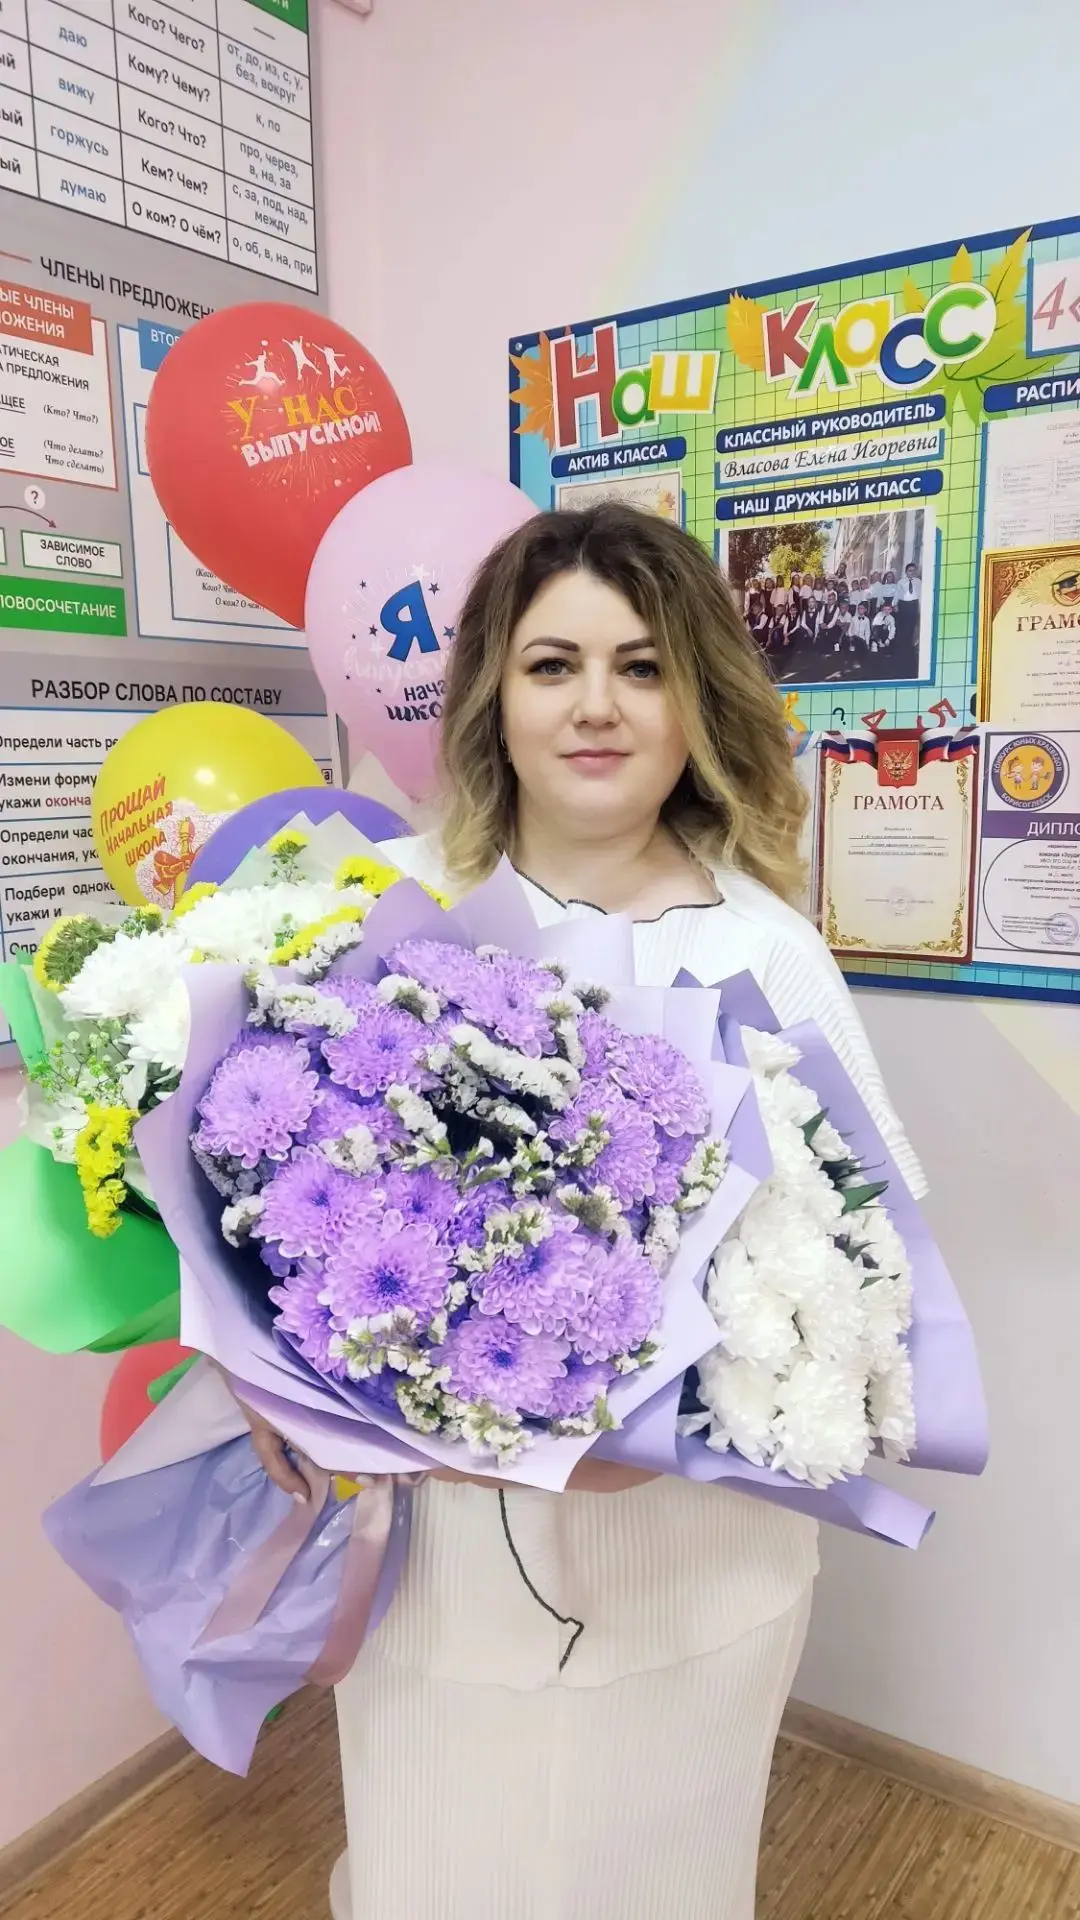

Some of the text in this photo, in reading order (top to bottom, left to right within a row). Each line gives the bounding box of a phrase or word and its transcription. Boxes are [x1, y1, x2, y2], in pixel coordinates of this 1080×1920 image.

[59, 26, 87, 48] даю
[128, 4, 205, 53] Кого? Чего?
[227, 43, 243, 60] от,
[245, 52, 262, 71] до,
[58, 77, 94, 104] вижу
[128, 53, 210, 102] Кому? Чему?
[235, 63, 296, 104] без, вокруг
[0, 109, 23, 127] ый
[138, 108, 206, 148] Кого? Что?
[256, 113, 281, 133] к, по
[50, 125, 109, 156] горжусь
[0, 157, 21, 175] ый
[240, 141, 298, 178] про, через,
[141, 157, 208, 195] Кем? Чем?
[261, 170, 277, 186] на,
[280, 178, 291, 190] за
[60, 178, 107, 203] думаю
[244, 189, 260, 206] за,
[262, 195, 284, 215] под,
[287, 207, 308, 224] над,
[132, 201, 221, 244] О ком? О чём?
[254, 211, 290, 235] между
[245, 241, 261, 258] об,
[294, 259, 313, 275] при
[40, 256, 215, 320] ЧЛЕНЫ ПРЕДЛОЖЕН
[23, 293, 75, 320] ЧЛЕНЫ
[0, 310, 65, 339] ОЖЕНИЯ
[0, 343, 60, 367] ТИЧЕСКАЯ
[6, 362, 90, 391] ПРЕДЛОЖЕНИЯ
[0, 394, 26, 409] ЩЕЕ
[43, 404, 99, 425] (Кто? Что?)
[226, 386, 357, 441] У НАС
[241, 411, 382, 467] ВЫПУСКНОЙ!
[724, 403, 936, 448] КЛАССНЫЙ РУКОВОДИТЕЛЬ
[43, 439, 104, 458] (Что делать?
[568, 443, 668, 472] АКТИВ КЛАССА
[724, 435, 938, 478] Власова Елена Игоревна
[45, 454, 104, 474] Что сделать)
[734, 477, 921, 516] НАШ ДРУЖНЫЙ КЛАСС
[40, 539, 105, 557] ЗАВИСИМОЕ
[55, 555, 92, 569] СЛОВО
[380, 579, 441, 662] Я
[1016, 613, 1080, 632] ГРАМ
[31, 679, 282, 705] РАЗБОР СЛОВА ПО СОСТАВУ
[66, 737, 102, 748] часть
[54, 772, 98, 788] форму
[0, 797, 41, 812] укажи
[100, 773, 166, 836] ПРОЩАЙ
[853, 795, 944, 811] ГРАМОТА
[0, 829, 69, 845] Определи
[105, 801, 173, 856] НАЧАЛЬНАЯ
[2, 849, 99, 866] окончания, ук
[125, 831, 167, 867] ШКОЛА
[4, 885, 66, 901] Подбери
[6, 908, 50, 926] укажи
